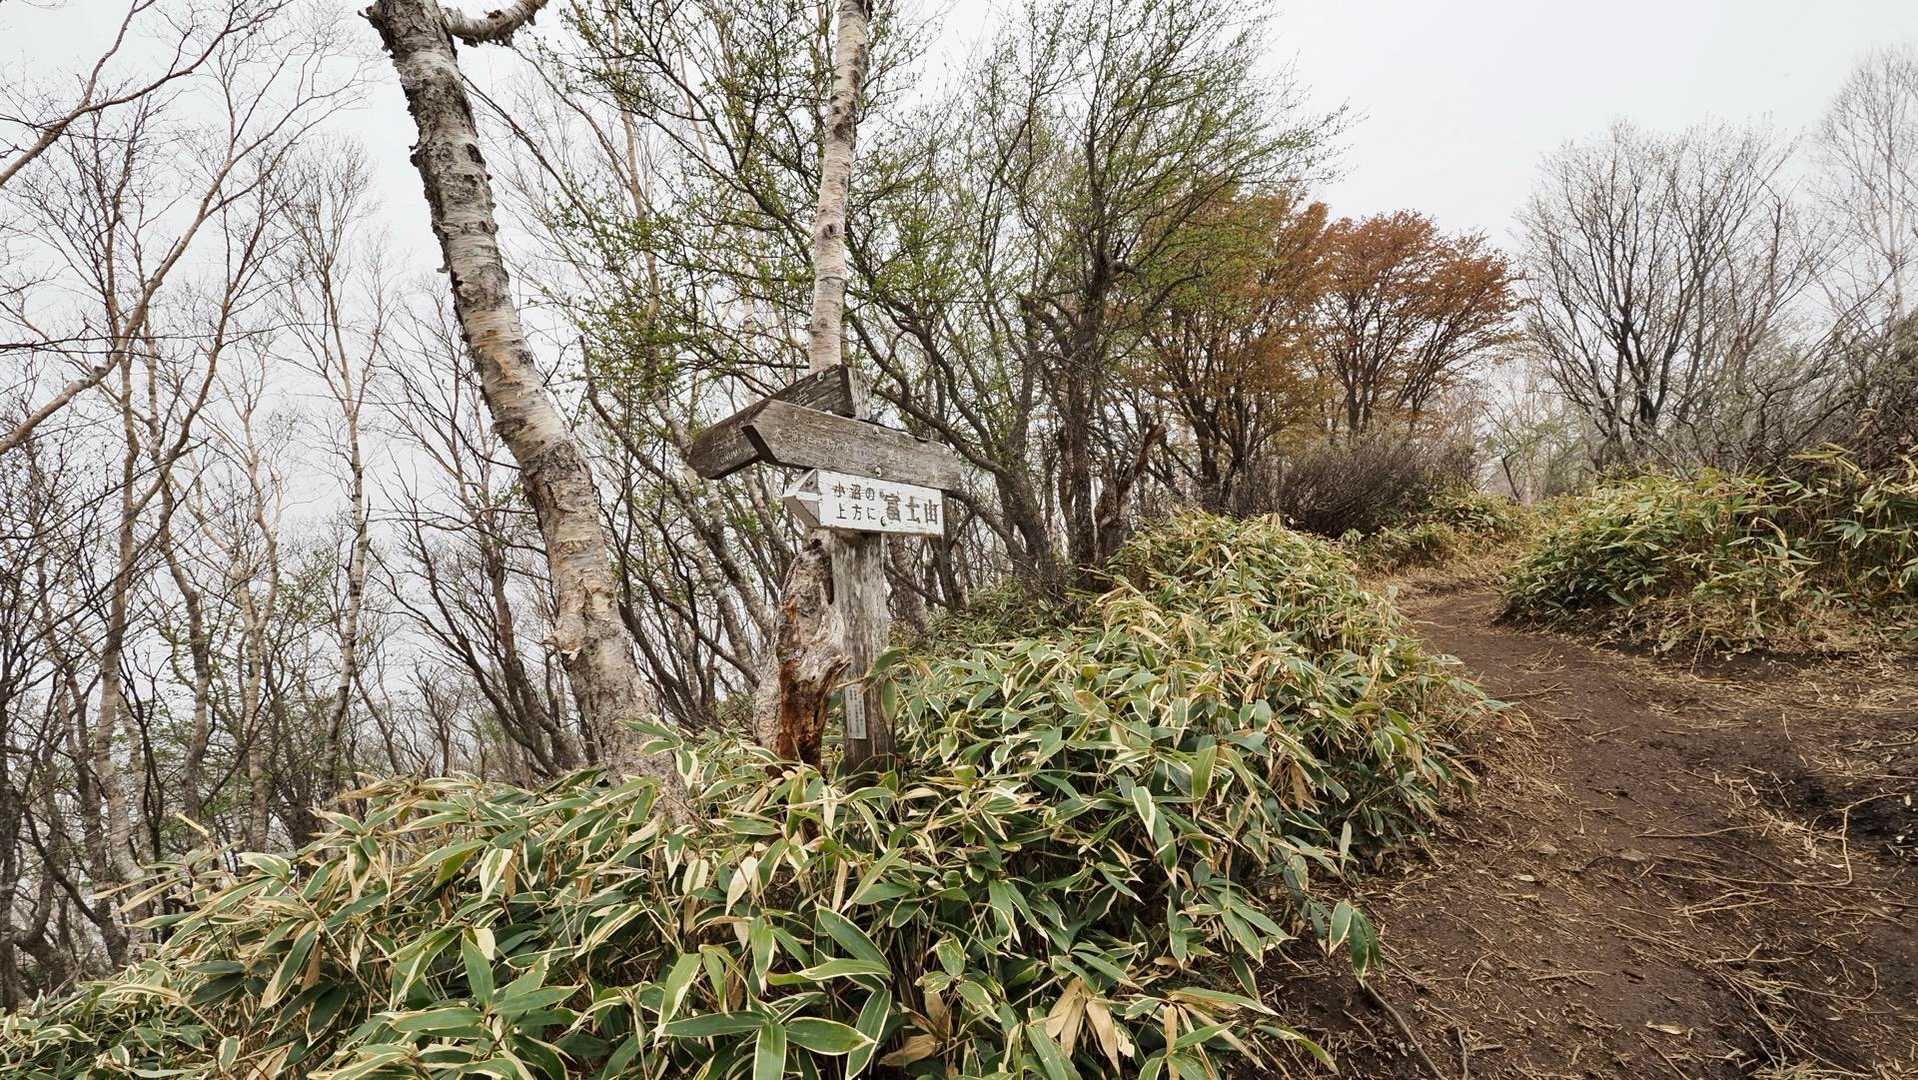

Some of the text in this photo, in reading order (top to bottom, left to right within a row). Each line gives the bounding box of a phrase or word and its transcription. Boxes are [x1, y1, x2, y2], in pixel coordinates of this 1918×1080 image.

[836, 503, 876, 520] 上方に
[884, 493, 939, 525] 富士山
